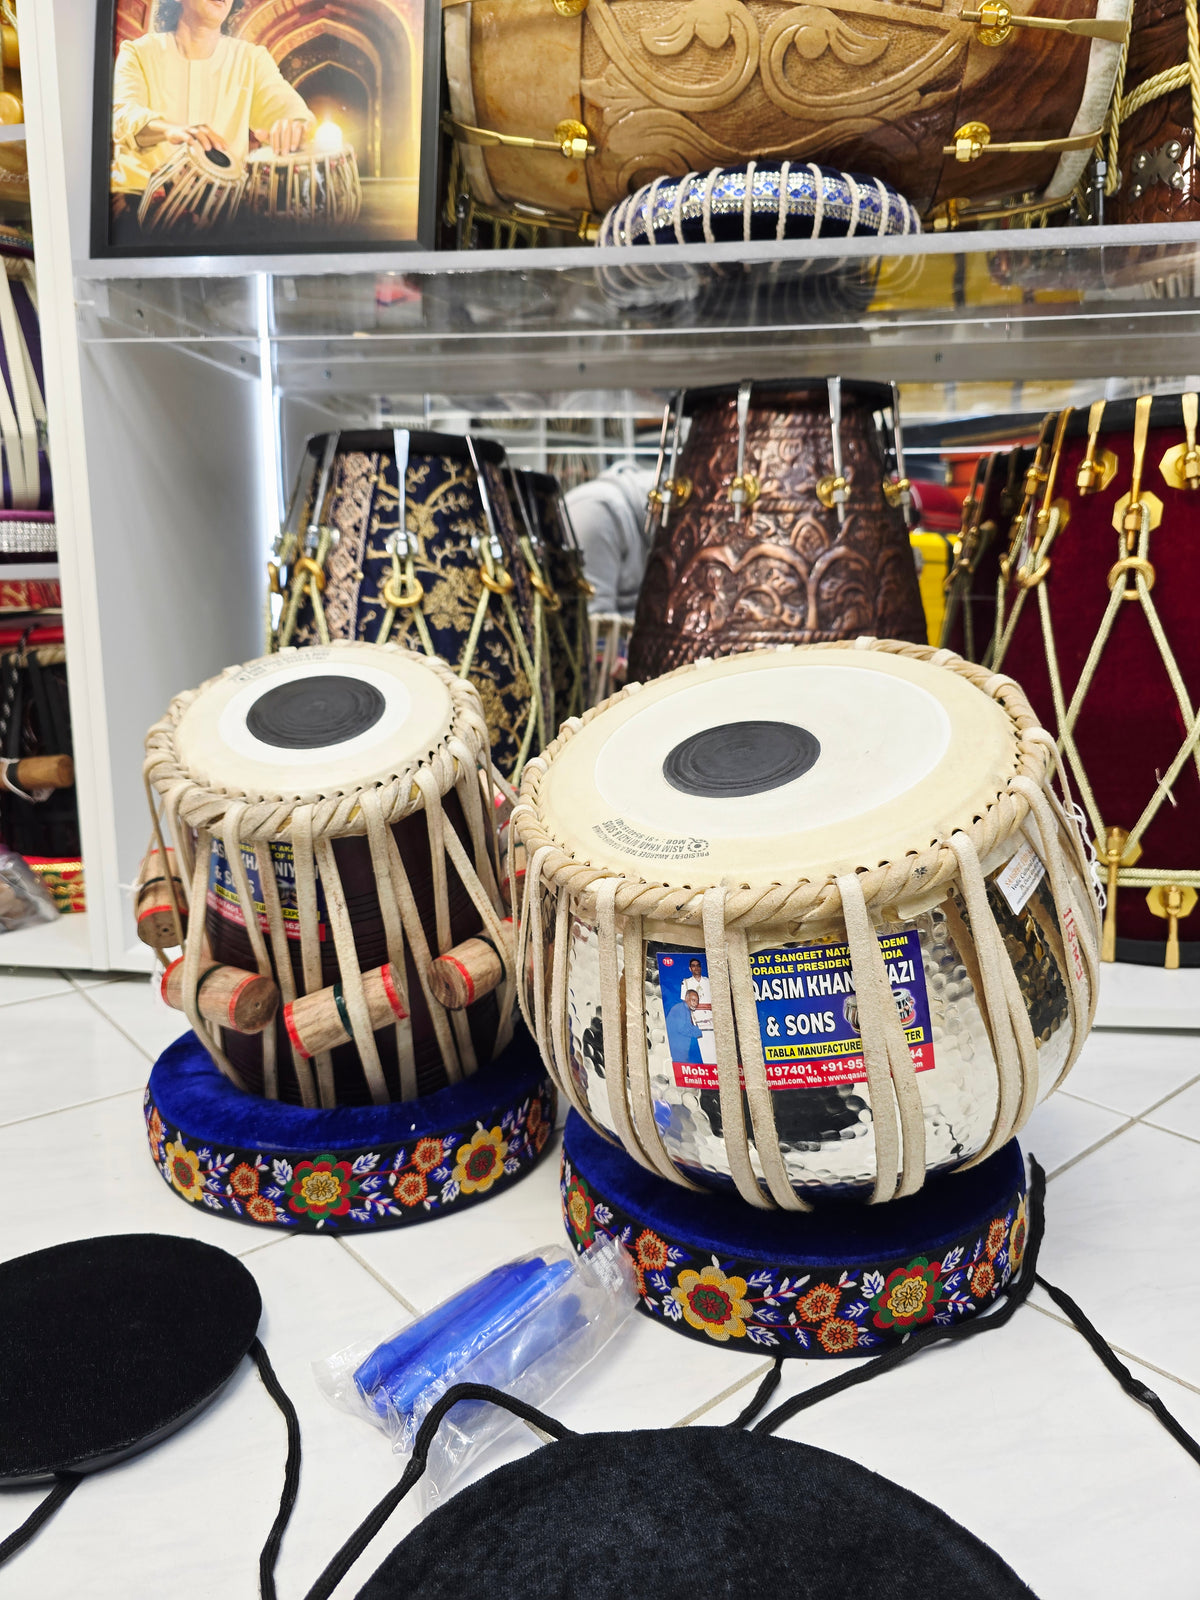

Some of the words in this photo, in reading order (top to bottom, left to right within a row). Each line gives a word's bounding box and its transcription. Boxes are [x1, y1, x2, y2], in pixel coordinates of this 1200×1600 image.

[758, 955, 771, 964] BY
[774, 950, 823, 963] SANGEET
[878, 936, 909, 949] ADEMI
[796, 958, 851, 972] PRESIDEN
[806, 971, 856, 997] KHAN
[886, 960, 915, 985] AZI
[766, 1016, 781, 1037] &
[784, 1011, 836, 1036] SONS
[768, 1047, 796, 1058] TABLA
[797, 1041, 861, 1056] MANUFACTURE
[681, 1065, 709, 1076] Mob:
[767, 1064, 817, 1077] 197401,
[820, 1058, 864, 1072] +91-95
[684, 1077, 702, 1085] Email
[806, 1075, 822, 1084] Web
